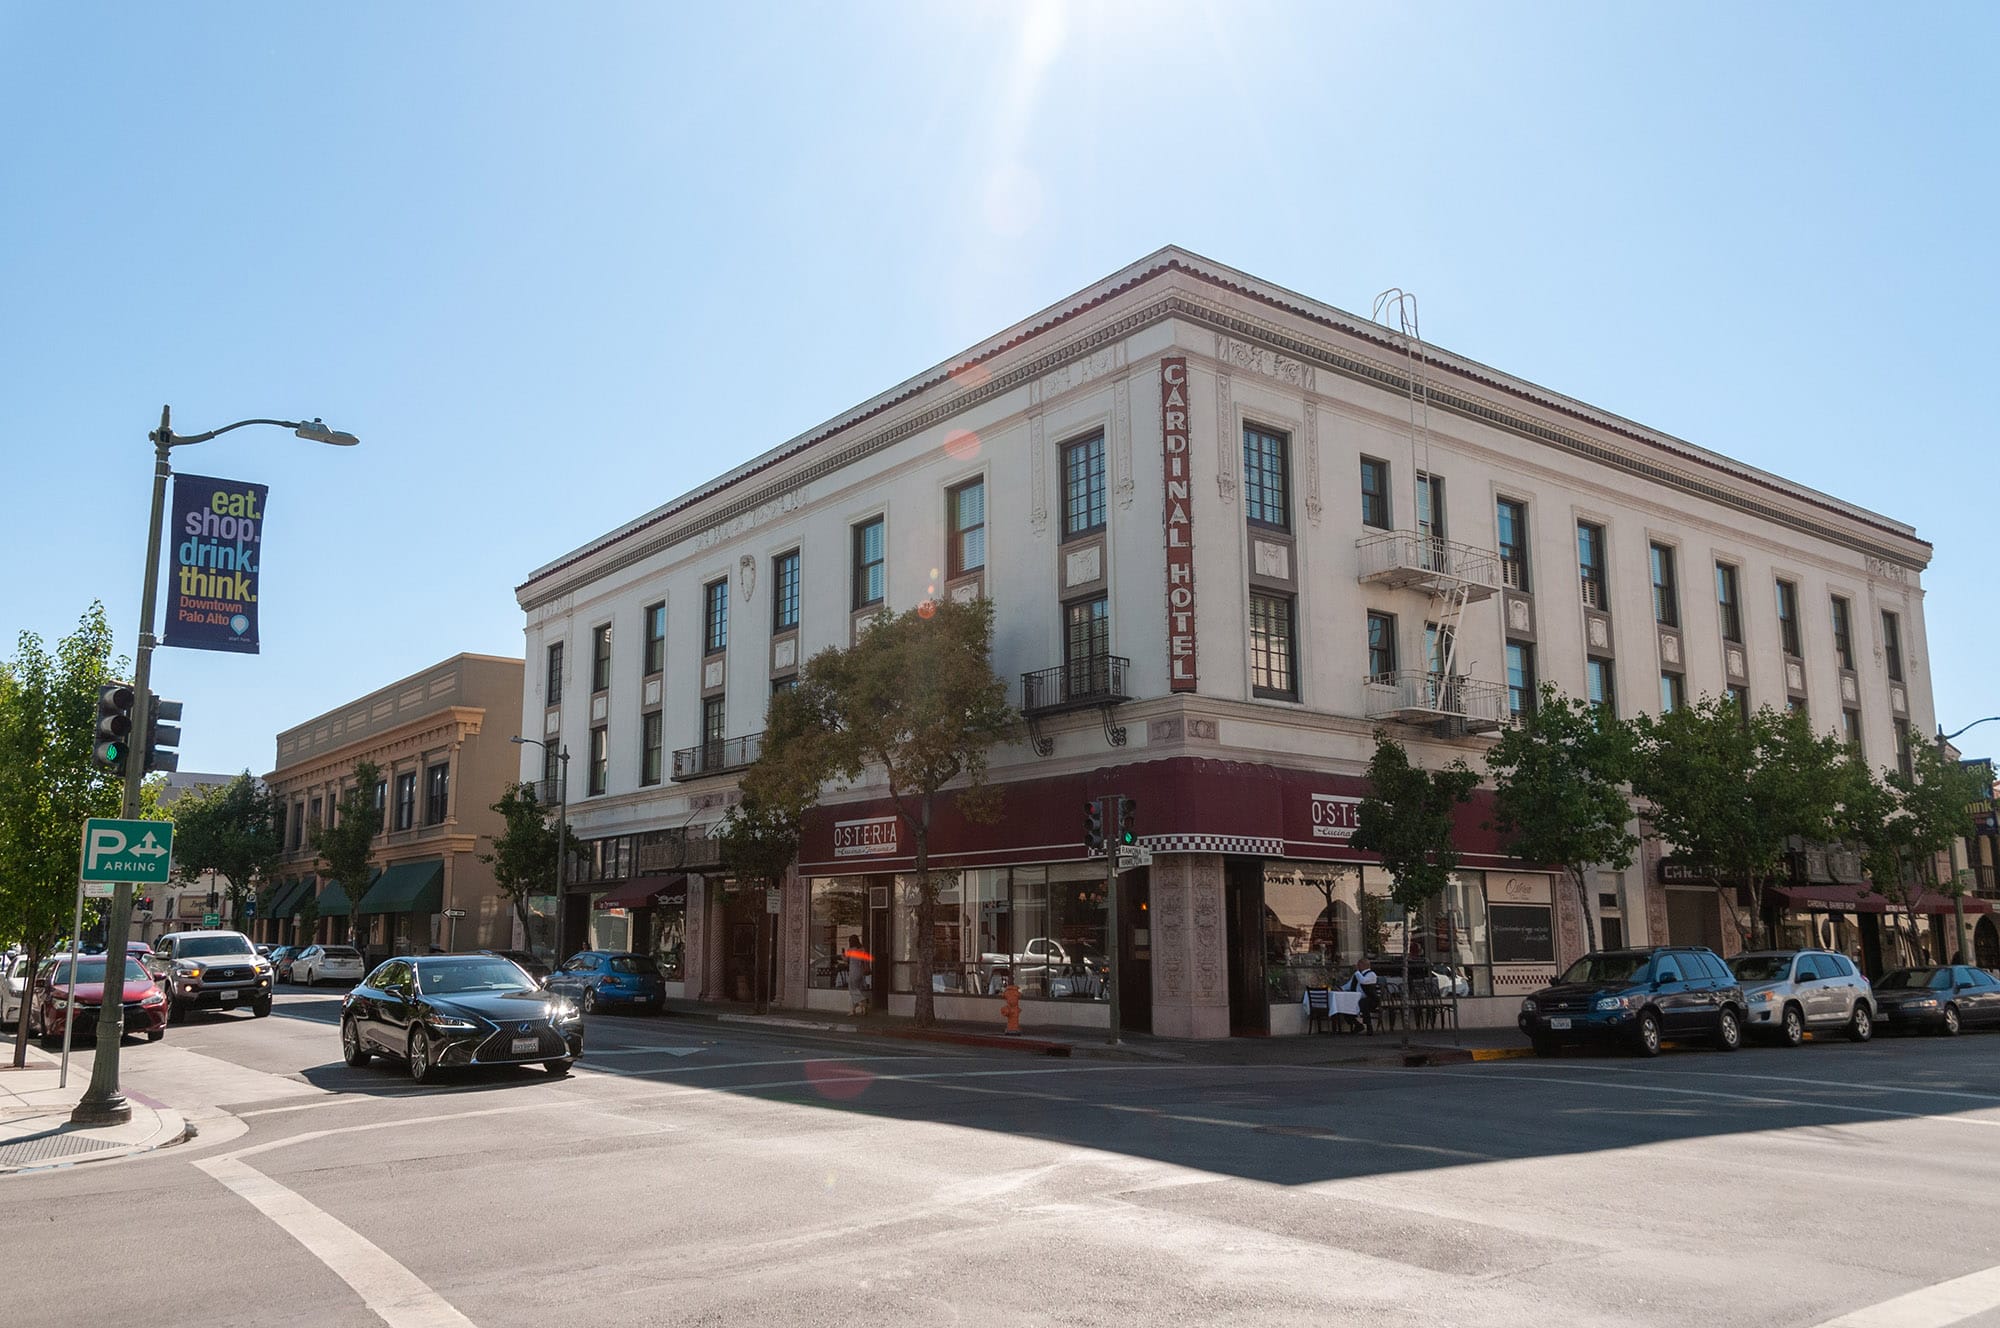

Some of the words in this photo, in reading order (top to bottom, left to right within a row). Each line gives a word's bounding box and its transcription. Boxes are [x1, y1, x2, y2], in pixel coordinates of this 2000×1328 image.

[1164, 364, 1190, 548] CARDINAL
[212, 490, 262, 519] eat.
[185, 507, 260, 543] shop.
[179, 536, 258, 573] drink.
[179, 566, 257, 602] think.
[179, 610, 204, 624] Palo
[206, 612, 230, 626] Alto
[180, 596, 242, 613] Downtown
[1170, 563, 1194, 679] HOTEL
